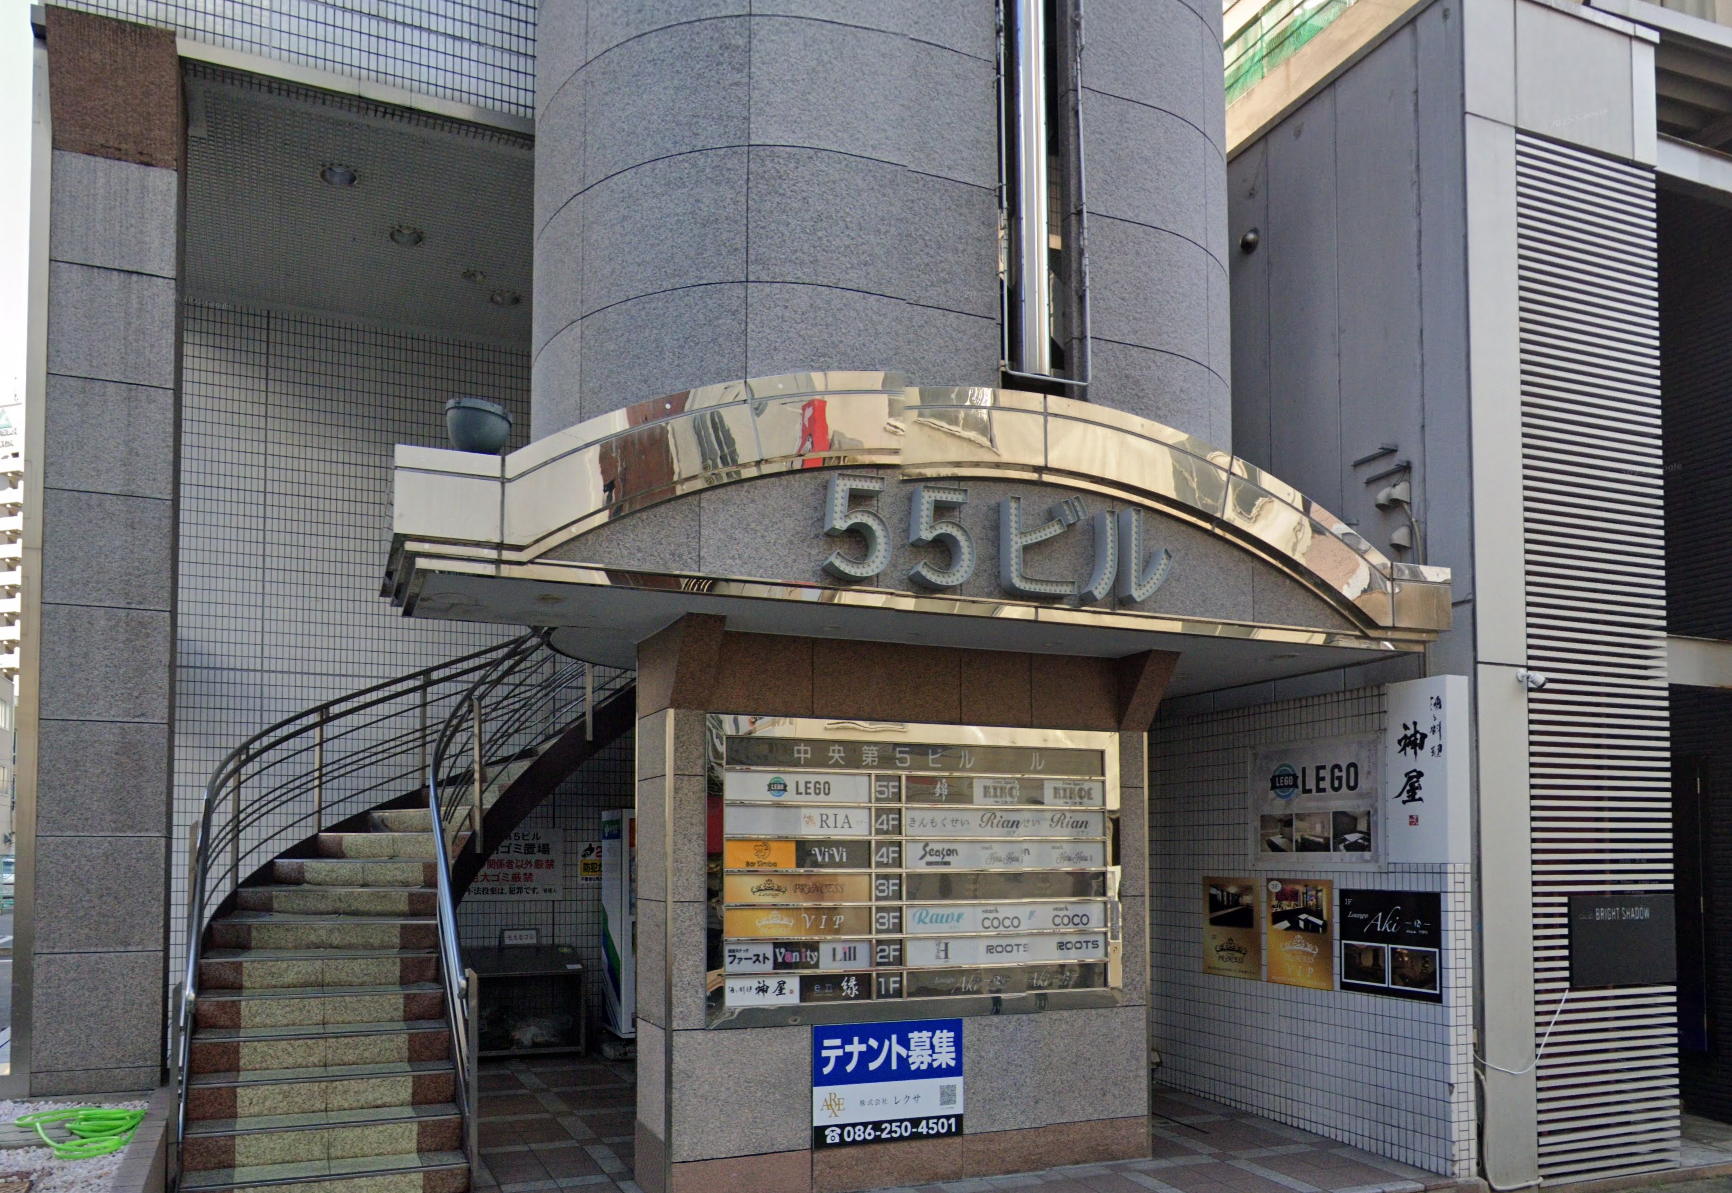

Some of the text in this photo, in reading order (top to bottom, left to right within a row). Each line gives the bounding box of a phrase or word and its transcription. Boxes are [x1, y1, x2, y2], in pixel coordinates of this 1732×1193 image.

[1276, 776, 1294, 786] LEGO
[1302, 762, 1359, 795] LEGO
[795, 780, 831, 796] LEGO
[875, 781, 900, 798] 5F
[819, 813, 853, 829] RIA
[875, 814, 900, 831] 4F
[908, 816, 970, 828] きんもくせい
[979, 812, 1020, 830] Rian
[1049, 812, 1090, 830] Rian
[492, 843, 551, 856] ゴミ置場
[811, 848, 846, 862] ViVi
[875, 847, 900, 864] 4F
[918, 842, 959, 860] Season
[876, 880, 900, 897] 3F
[876, 912, 900, 930] 3F
[1052, 914, 1090, 926] COCO
[1364, 906, 1402, 934] Aki
[1595, 907, 1620, 921] BRIGHT
[1622, 906, 1650, 920] SHADOW
[981, 916, 1022, 930] COCO
[876, 945, 900, 962] 2F
[1056, 940, 1100, 951] ROOTS
[728, 953, 770, 966] ファースト
[774, 948, 819, 965] Vanity
[878, 977, 900, 994] 1F
[821, 1029, 956, 1076] テナント募集
[860, 1094, 922, 1107] 株式会社 レクサ
[844, 1118, 956, 1142] 086-250-4501
